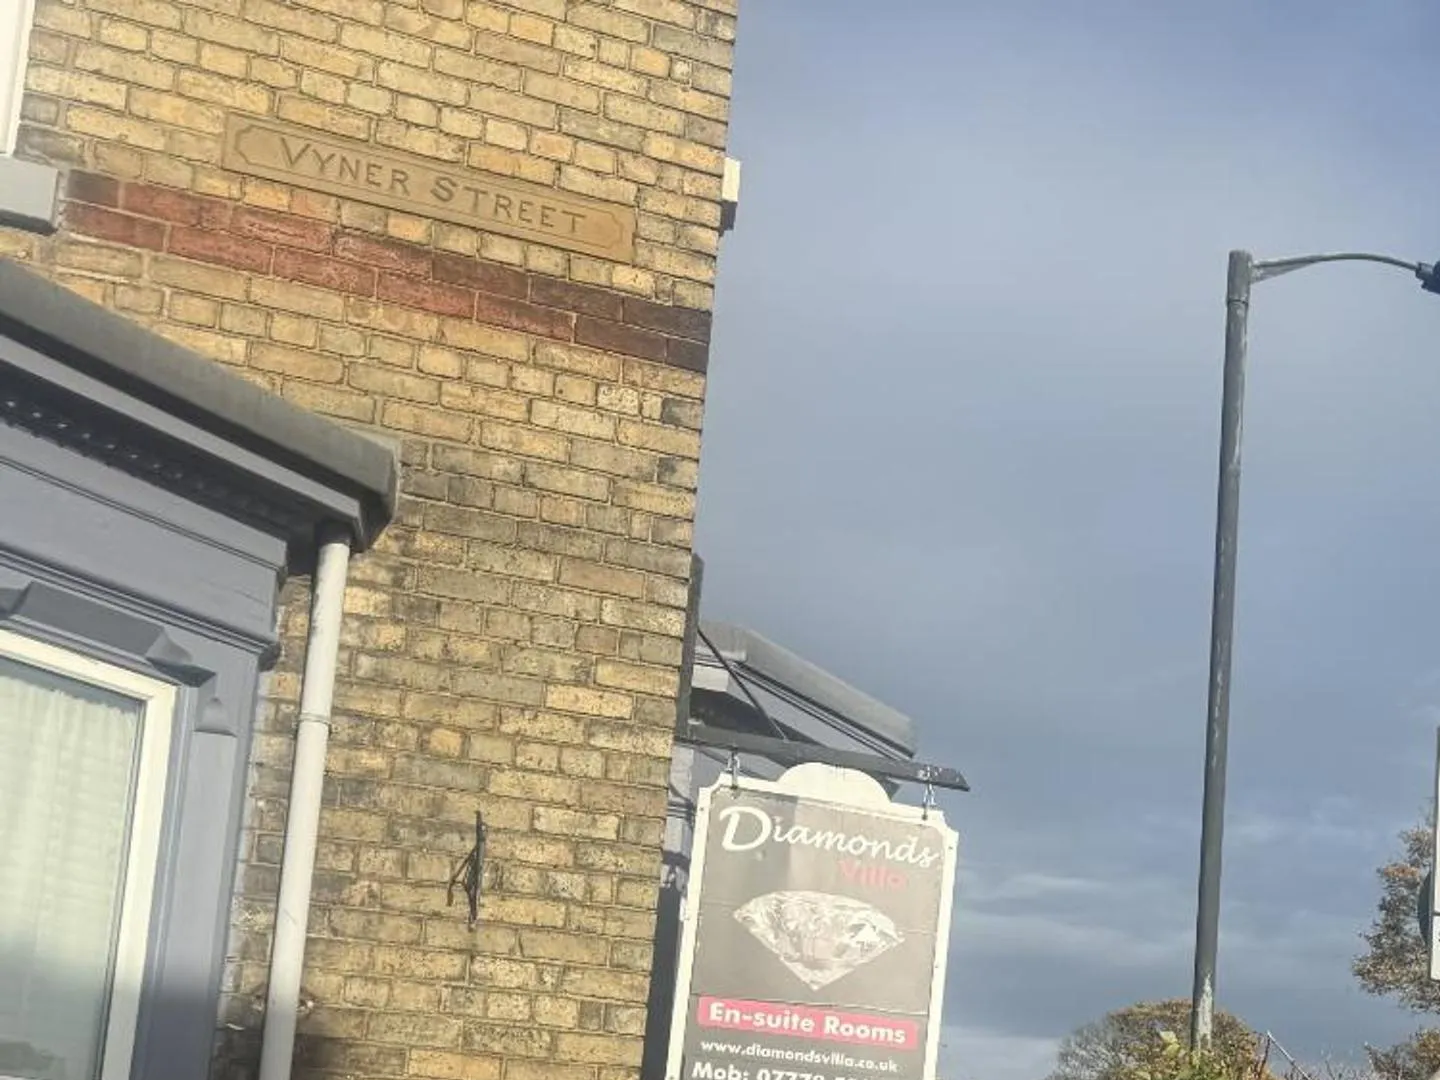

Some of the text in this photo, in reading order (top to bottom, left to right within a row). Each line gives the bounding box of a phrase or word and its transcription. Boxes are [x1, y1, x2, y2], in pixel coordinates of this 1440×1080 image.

[280, 137, 588, 234] VYNER STREET
[719, 806, 941, 868] Diamonds
[838, 860, 907, 889] Villa
[709, 1002, 906, 1044] En-suite Rooms
[701, 1040, 899, 1073] www.diamondsvilla.co.uk
